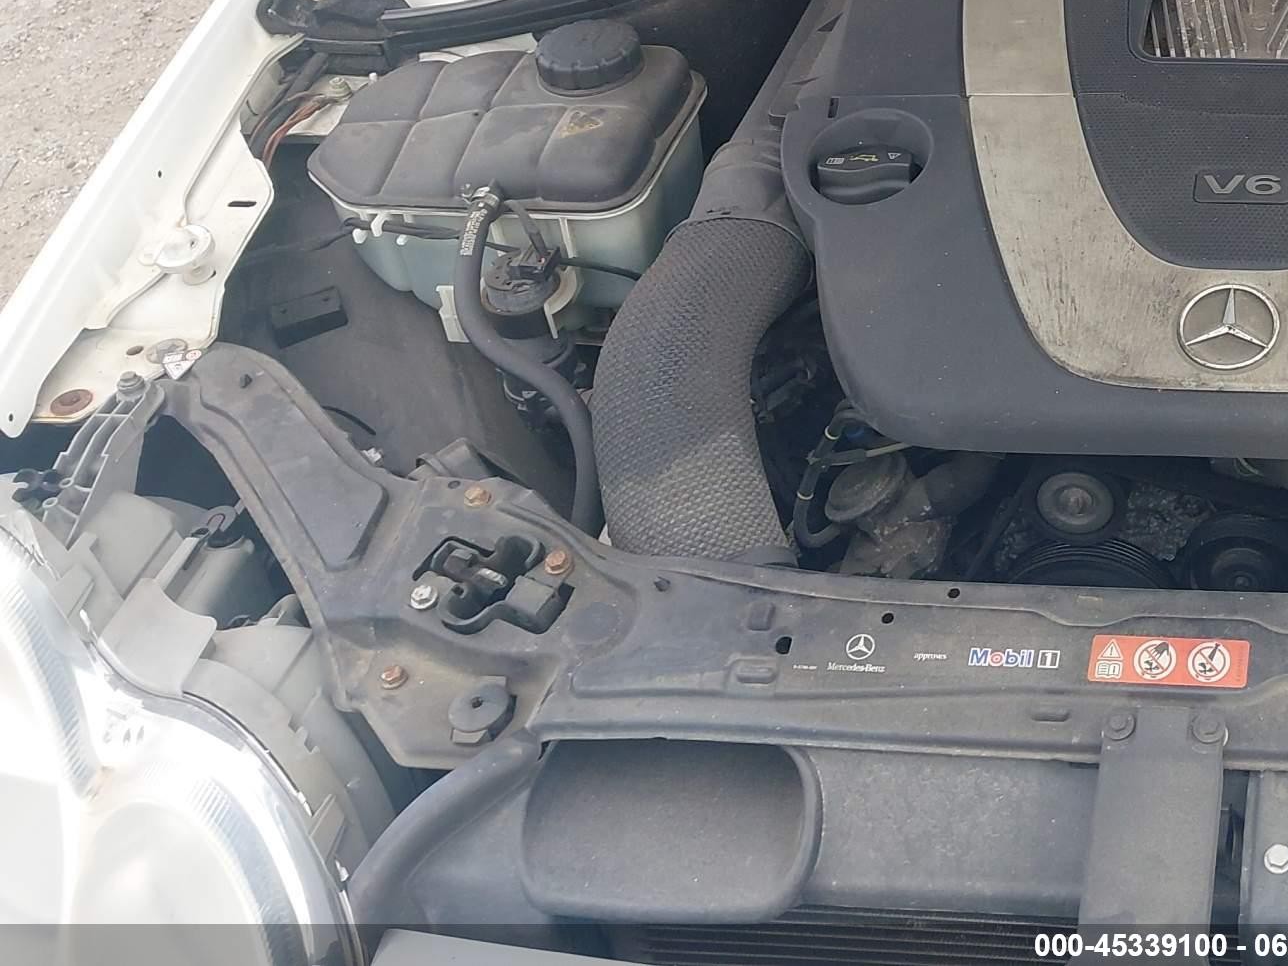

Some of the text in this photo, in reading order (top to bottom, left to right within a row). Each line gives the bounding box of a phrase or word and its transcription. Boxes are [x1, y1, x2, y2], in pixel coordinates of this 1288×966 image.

[1203, 174, 1282, 195] V6
[826, 661, 886, 674] Mercedes-Benz
[967, 647, 1035, 668] Mobil
